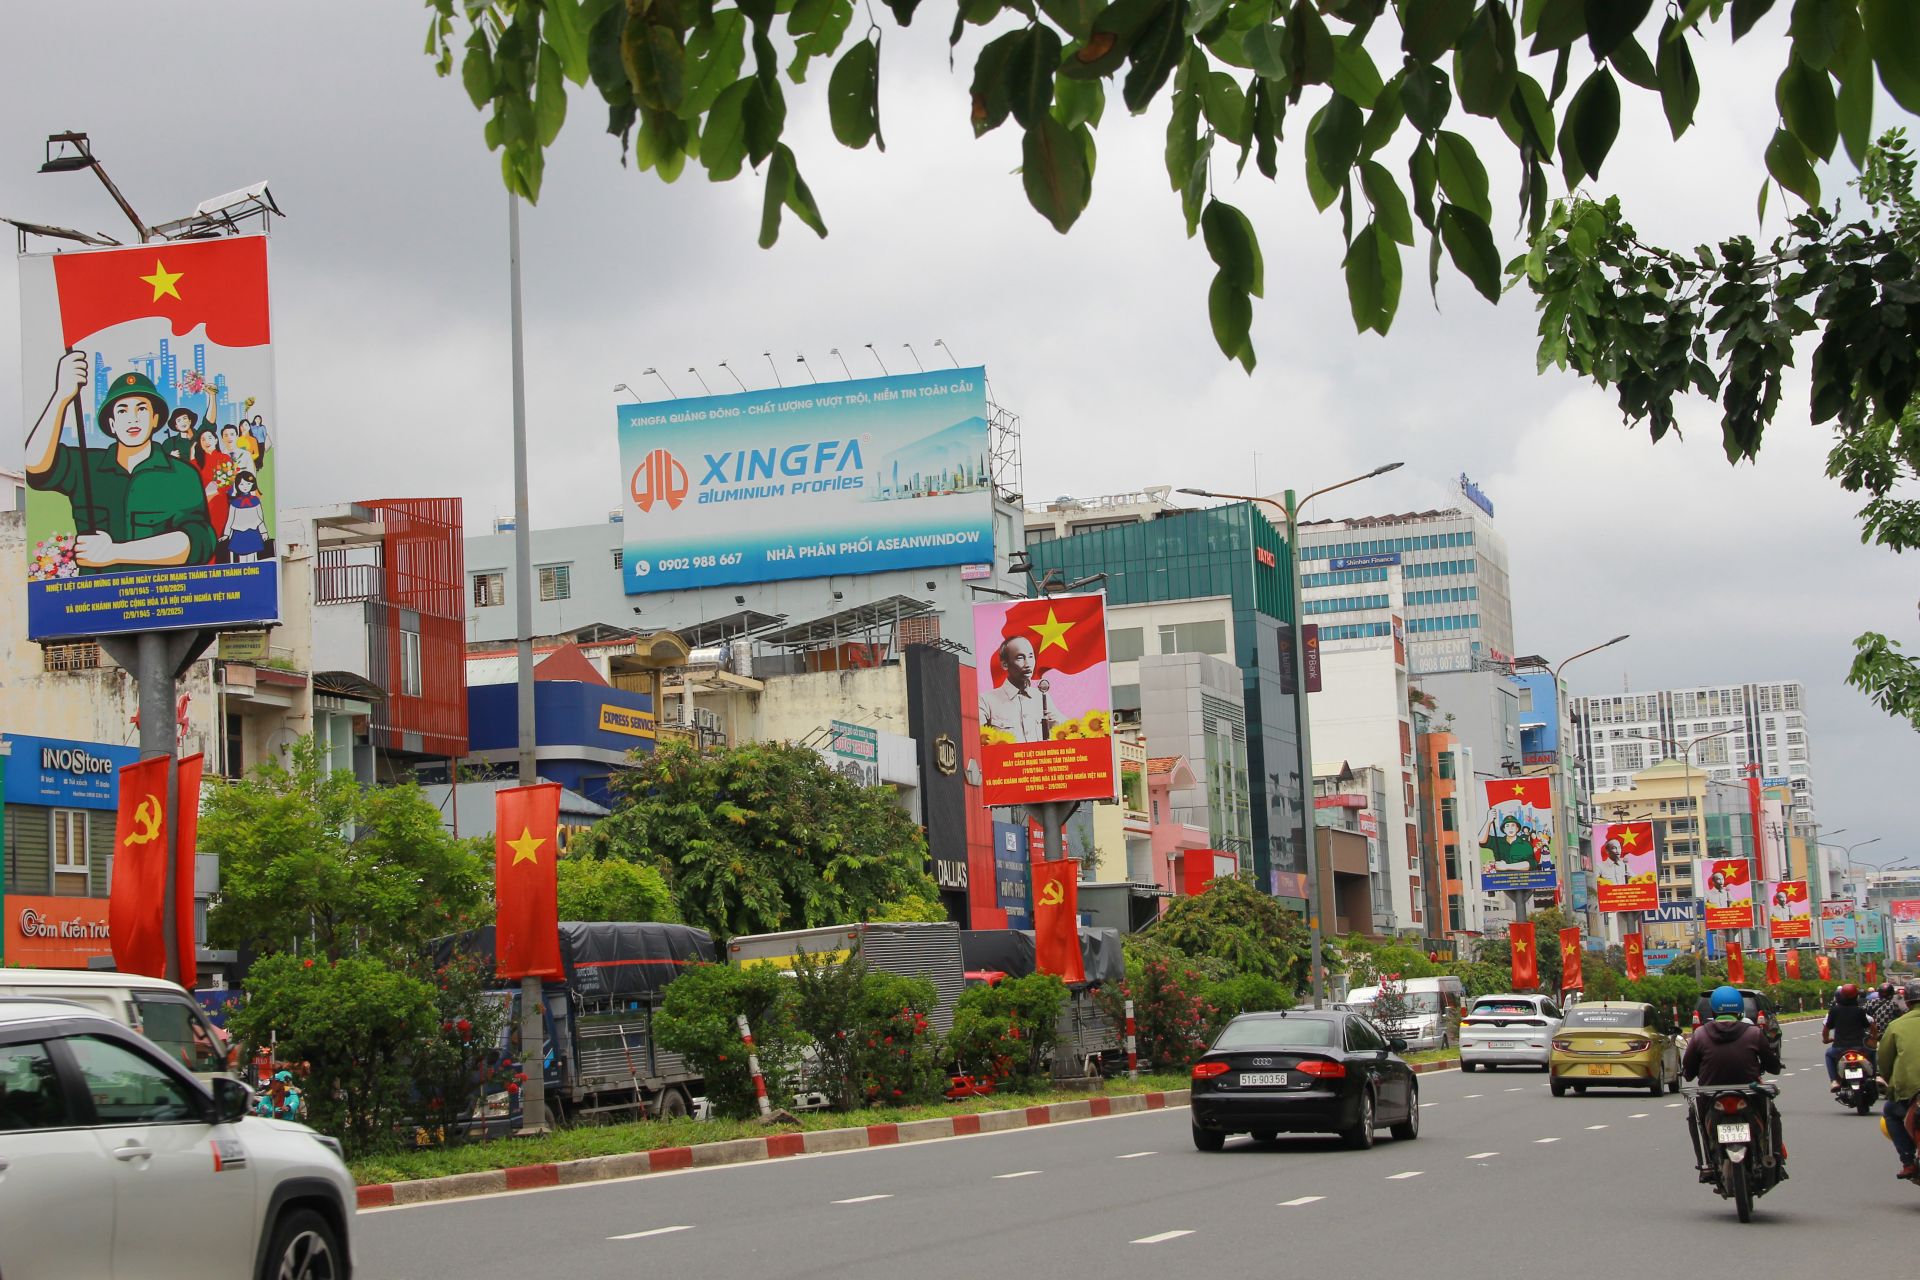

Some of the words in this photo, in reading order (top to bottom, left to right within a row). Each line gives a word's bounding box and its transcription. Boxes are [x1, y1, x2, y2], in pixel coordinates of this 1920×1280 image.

[631, 416, 667, 427] XINGFA
[669, 410, 706, 423] QUẢNG
[709, 407, 740, 419] ĐÔNG
[748, 400, 776, 415] CHẤT
[778, 397, 813, 412] LƯỢNG
[816, 396, 842, 409] VƯỢT
[845, 391, 871, 404] TRỘI,
[873, 387, 898, 401] NIỀM
[901, 388, 917, 399] TIN
[919, 385, 948, 397] TOÀN
[951, 379, 973, 393] CẦU
[699, 439, 864, 486] XINGFA
[766, 548, 796, 562] NHÀ
[799, 542, 836, 559] PHÂN
[839, 536, 873, 556] PHỐI
[876, 531, 980, 551] ASEANWINDOW
[658, 558, 690, 572] 0902
[692, 555, 716, 569] 988
[719, 552, 743, 566] 667
[1371, 556, 1393, 564] Finance
[46, 582, 62, 593] NHIỆT
[64, 581, 76, 592] LIỆT
[77, 579, 92, 589] CHÀO
[121, 576, 135, 586] NĂM
[136, 574, 151, 584] NGÀY
[153, 573, 168, 582] CÁCH
[170, 572, 187, 582] MẠNG
[189, 570, 208, 580] THÁNG
[209, 569, 222, 578] TÁM
[222, 568, 242, 577] THÀNH
[243, 566, 260, 576] CÔNG
[66, 604, 74, 614] VÀ
[74, 602, 90, 613] QUỐC
[92, 601, 112, 612] KHÁNH
[112, 600, 128, 610] NƯỚC
[130, 598, 146, 608] CỘNG
[147, 597, 158, 606] HÒA
[160, 596, 168, 605] XÃ
[170, 595, 180, 606] HỘI
[180, 593, 192, 603] CHỦ
[194, 592, 212, 602] NGHĨA
[213, 591, 225, 602] VIỆT
[227, 592, 240, 600] NAM
[1412, 643, 1434, 656] FOR
[1438, 641, 1466, 654] RENT
[1308, 649, 1318, 679] TPBank
[1419, 658, 1437, 671] 0908
[1456, 656, 1469, 668] 503
[604, 711, 630, 727] EXPRESS
[630, 716, 654, 732] SERVICE
[1087, 772, 1096, 780] VIỆT
[938, 860, 967, 888] DALLAS
[21, 908, 58, 938] Gốm
[60, 916, 88, 938] Kiến
[1242, 1075, 1286, 1084] 51G-903.56
[1722, 1125, 1744, 1133] 59-V2
